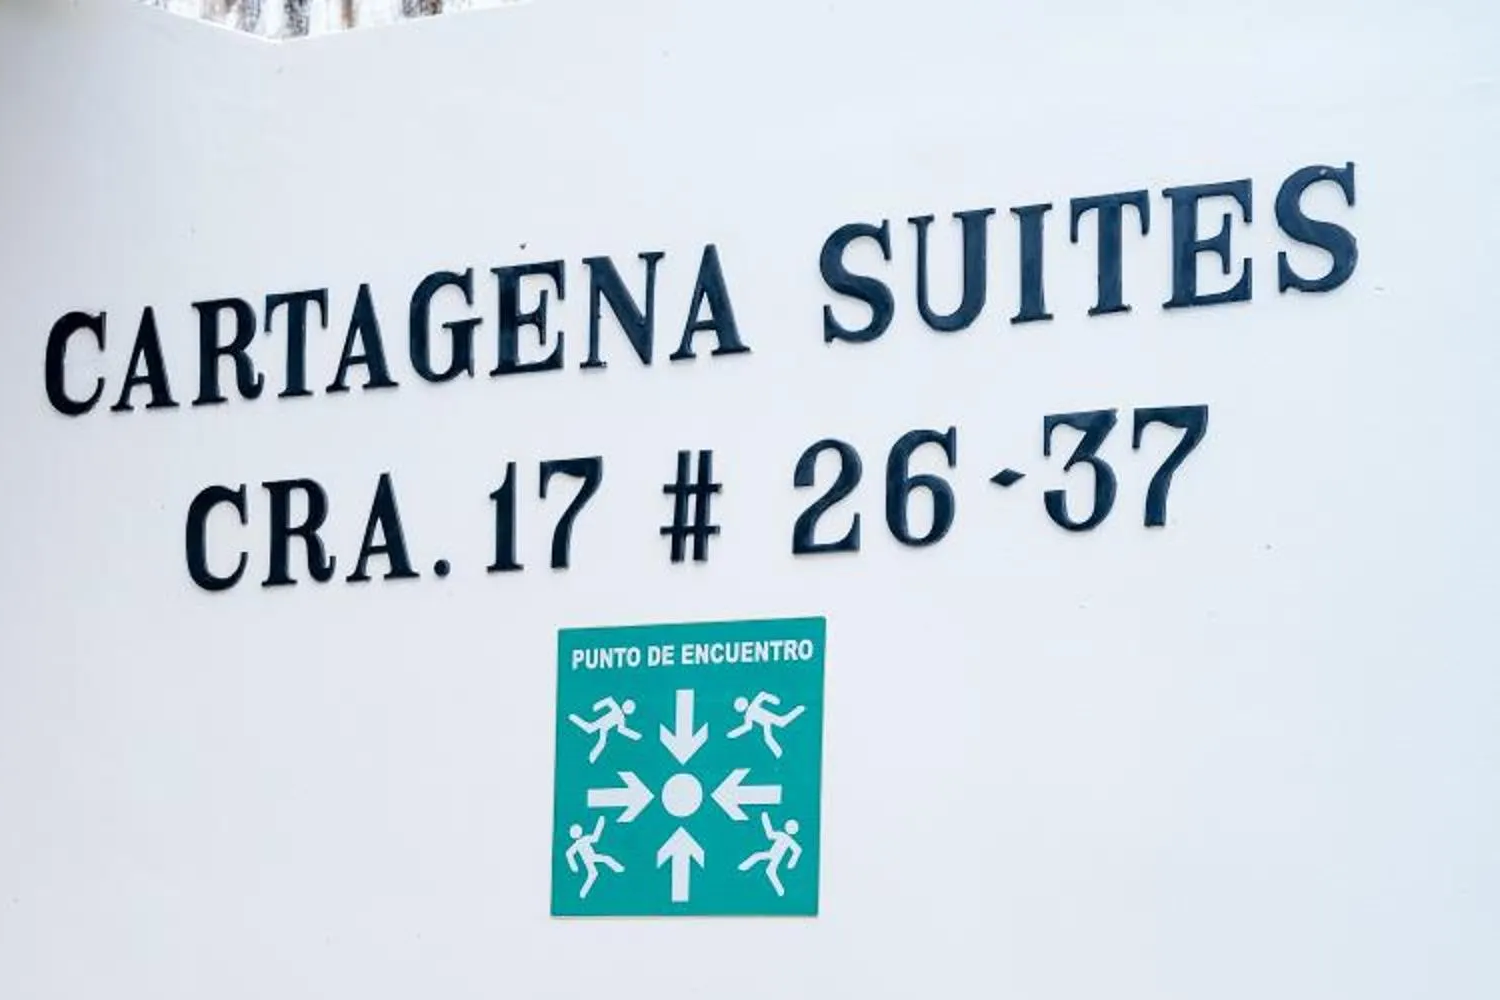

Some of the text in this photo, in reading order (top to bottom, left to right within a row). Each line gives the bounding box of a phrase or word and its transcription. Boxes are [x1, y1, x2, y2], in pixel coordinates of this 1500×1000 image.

[44, 161, 1358, 418] CARTAGENA SUITES
[659, 449, 723, 563] #
[571, 639, 814, 670] PUNTO DE ENCUENTRO
